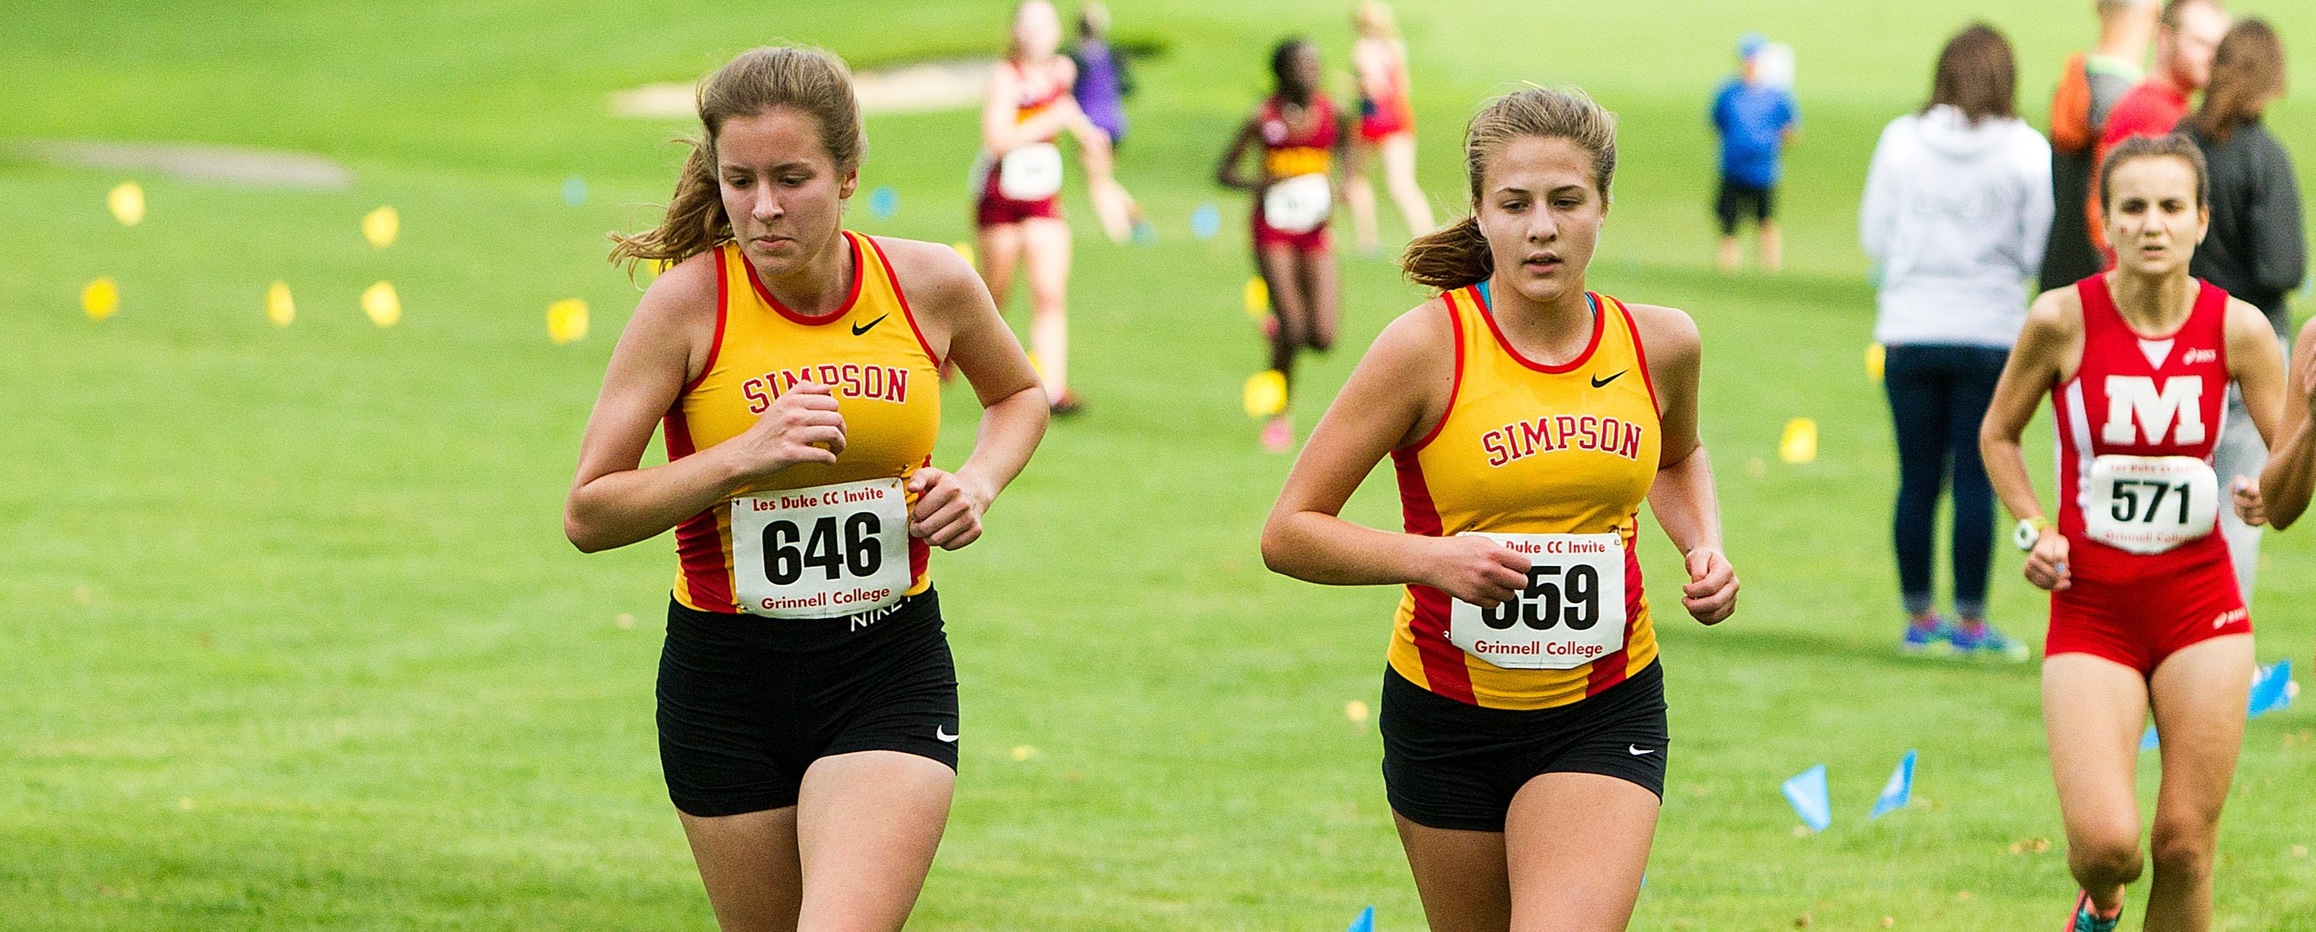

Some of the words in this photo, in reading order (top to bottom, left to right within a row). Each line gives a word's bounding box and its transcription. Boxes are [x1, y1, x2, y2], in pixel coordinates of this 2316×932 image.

[2102, 374, 2206, 446] M
[1482, 416, 1642, 467] SIMPSON
[753, 498, 776, 512] Les
[781, 495, 818, 510] Duke
[823, 491, 839, 505] CC
[844, 487, 884, 503] Invite
[2110, 478, 2192, 525] 571
[762, 511, 883, 586] 646
[1547, 541, 1563, 554] CC
[1568, 540, 1606, 553] Invite
[761, 592, 827, 609] Grinnell
[833, 588, 890, 605] College
[1475, 640, 1540, 655] Grinnell
[1546, 641, 1603, 658] College
